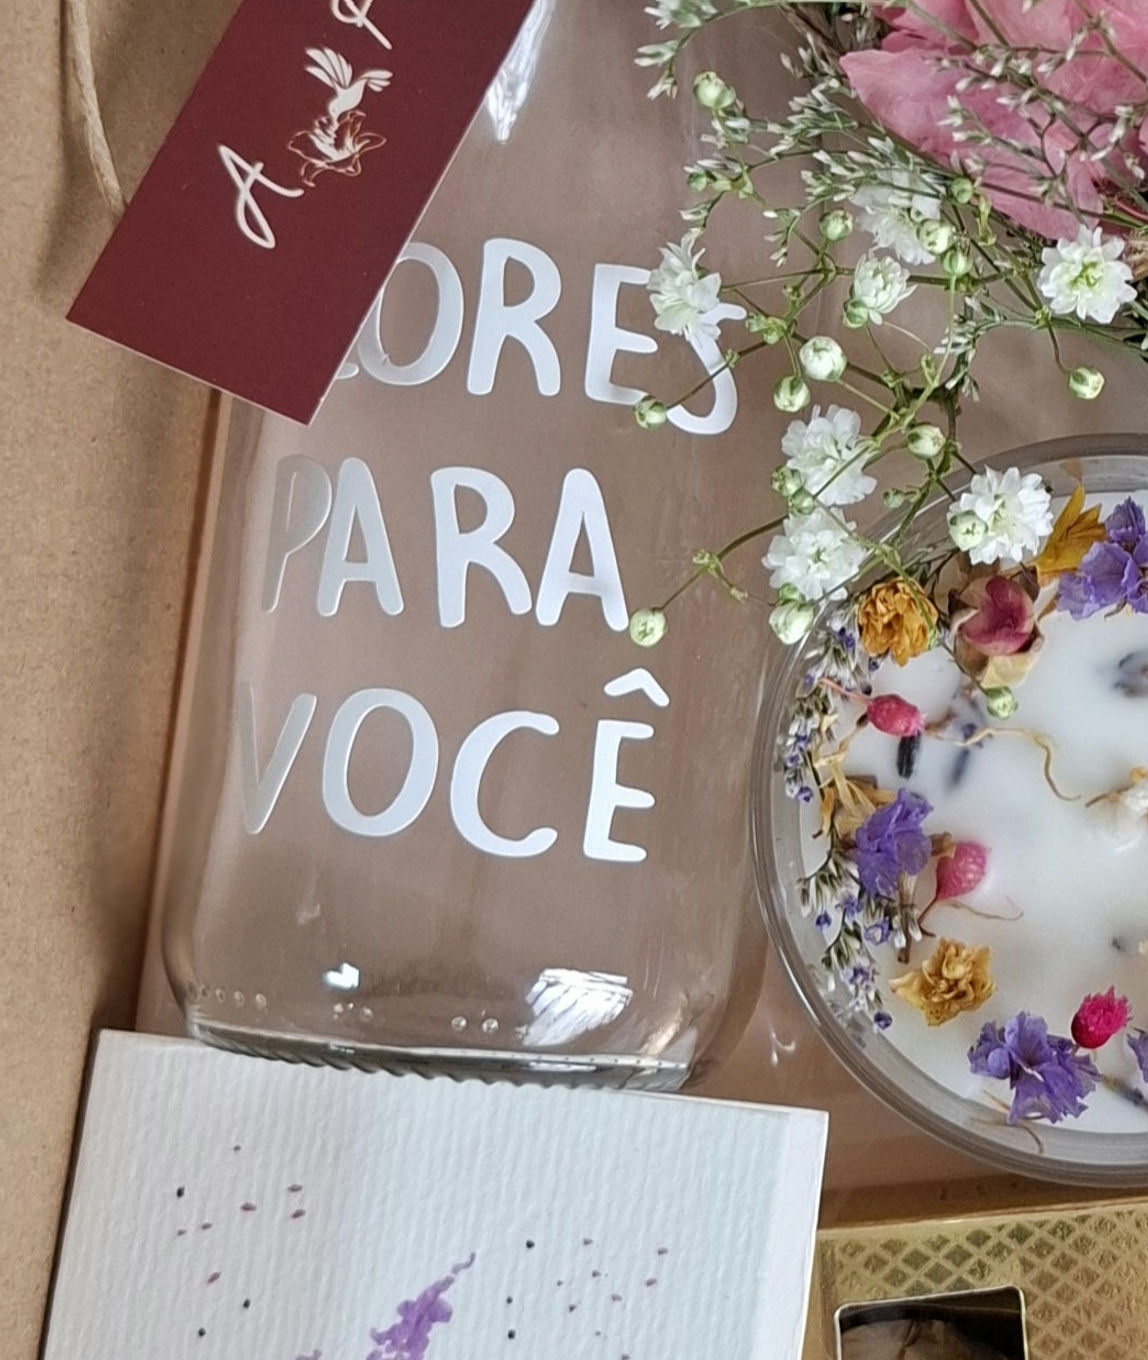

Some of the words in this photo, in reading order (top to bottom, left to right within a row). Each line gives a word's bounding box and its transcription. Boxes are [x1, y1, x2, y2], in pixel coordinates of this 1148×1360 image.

[217, 143, 304, 250] A
[338, 237, 748, 436] ORES
[261, 454, 630, 632] PARA
[238, 667, 670, 862] VOCÊ
